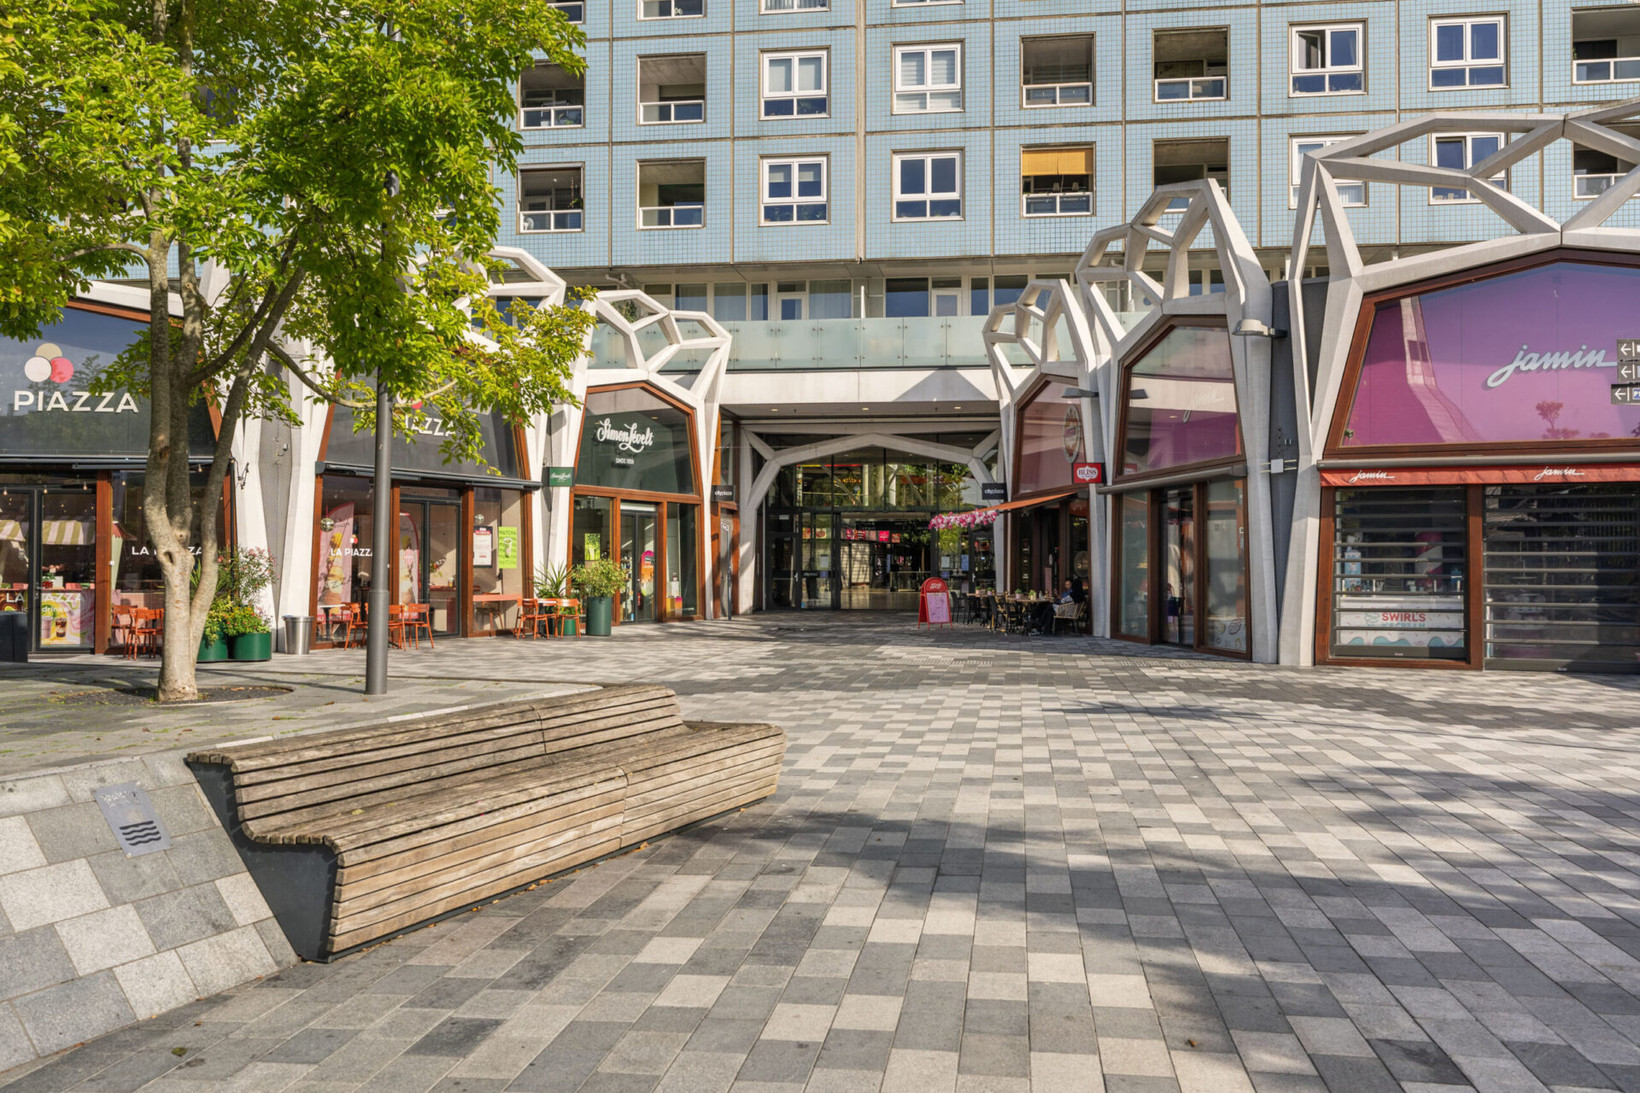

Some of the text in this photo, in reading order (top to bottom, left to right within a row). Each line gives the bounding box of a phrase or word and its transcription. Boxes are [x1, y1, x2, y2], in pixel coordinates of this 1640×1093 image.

[1486, 344, 1618, 388] jamin
[13, 390, 139, 413] PIAZZA
[1078, 468, 1097, 476] BLISS
[1348, 469, 1395, 484] jamin
[1533, 465, 1585, 481] jamin
[131, 546, 149, 556] LA
[330, 547, 373, 557] LA PIAZZ
[6, 592, 25, 603] LA
